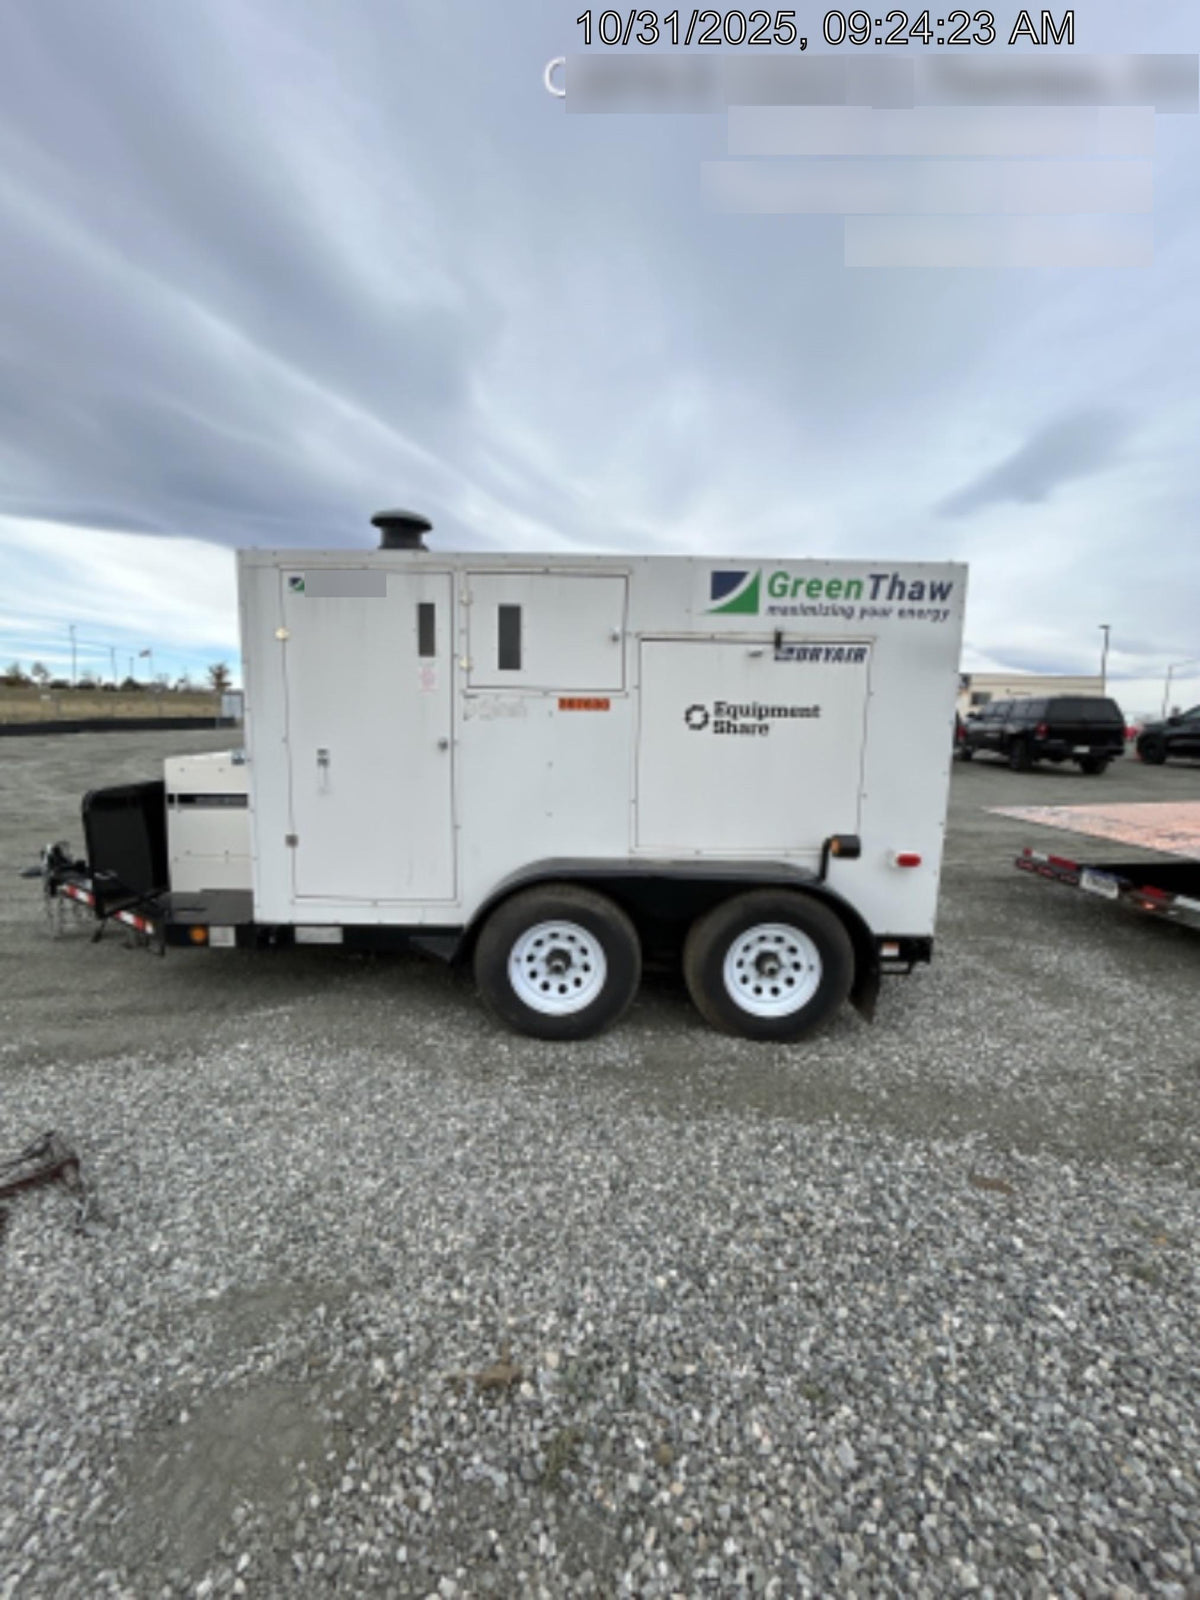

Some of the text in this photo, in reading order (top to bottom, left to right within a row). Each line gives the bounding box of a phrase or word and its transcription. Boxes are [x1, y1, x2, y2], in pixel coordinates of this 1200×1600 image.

[898, 607, 950, 622] energy
[713, 701, 821, 721] Equipment
[713, 719, 770, 736] Share
